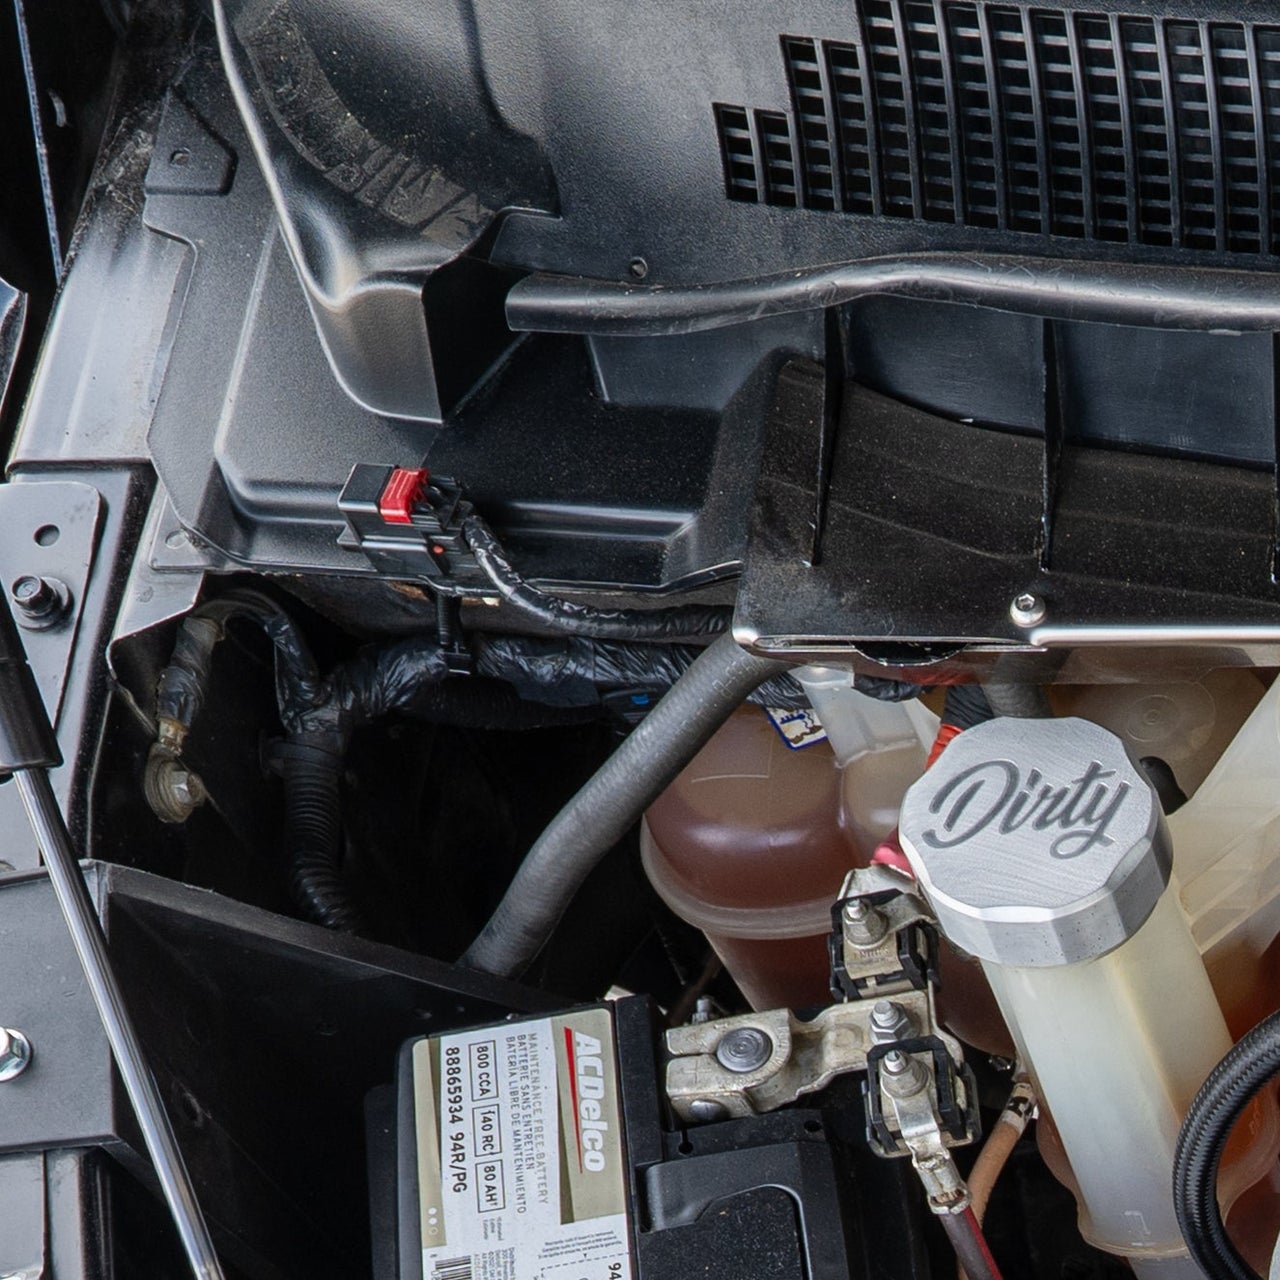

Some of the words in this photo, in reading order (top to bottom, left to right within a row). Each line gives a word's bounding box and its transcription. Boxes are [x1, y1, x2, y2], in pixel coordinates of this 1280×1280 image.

[921, 758, 1130, 860] Dirty
[445, 1045, 463, 1124] 88865934
[476, 1045, 489, 1069] 800
[516, 1033, 528, 1081] BATTERIE
[527, 1032, 542, 1115] MAINTENANCE
[507, 1080, 520, 1110] LIBRE
[509, 1112, 521, 1126] DE
[519, 1083, 530, 1111] SANS
[574, 1028, 610, 1174] ACDelco
[521, 1113, 534, 1170] ENTRETIEN
[532, 1118, 544, 1148] FREE
[447, 1132, 467, 1194] 94R/PG
[483, 1164, 496, 1181] 80
[510, 1128, 526, 1214] MANTENIMIENTO
[534, 1151, 548, 1206] BATTERY
